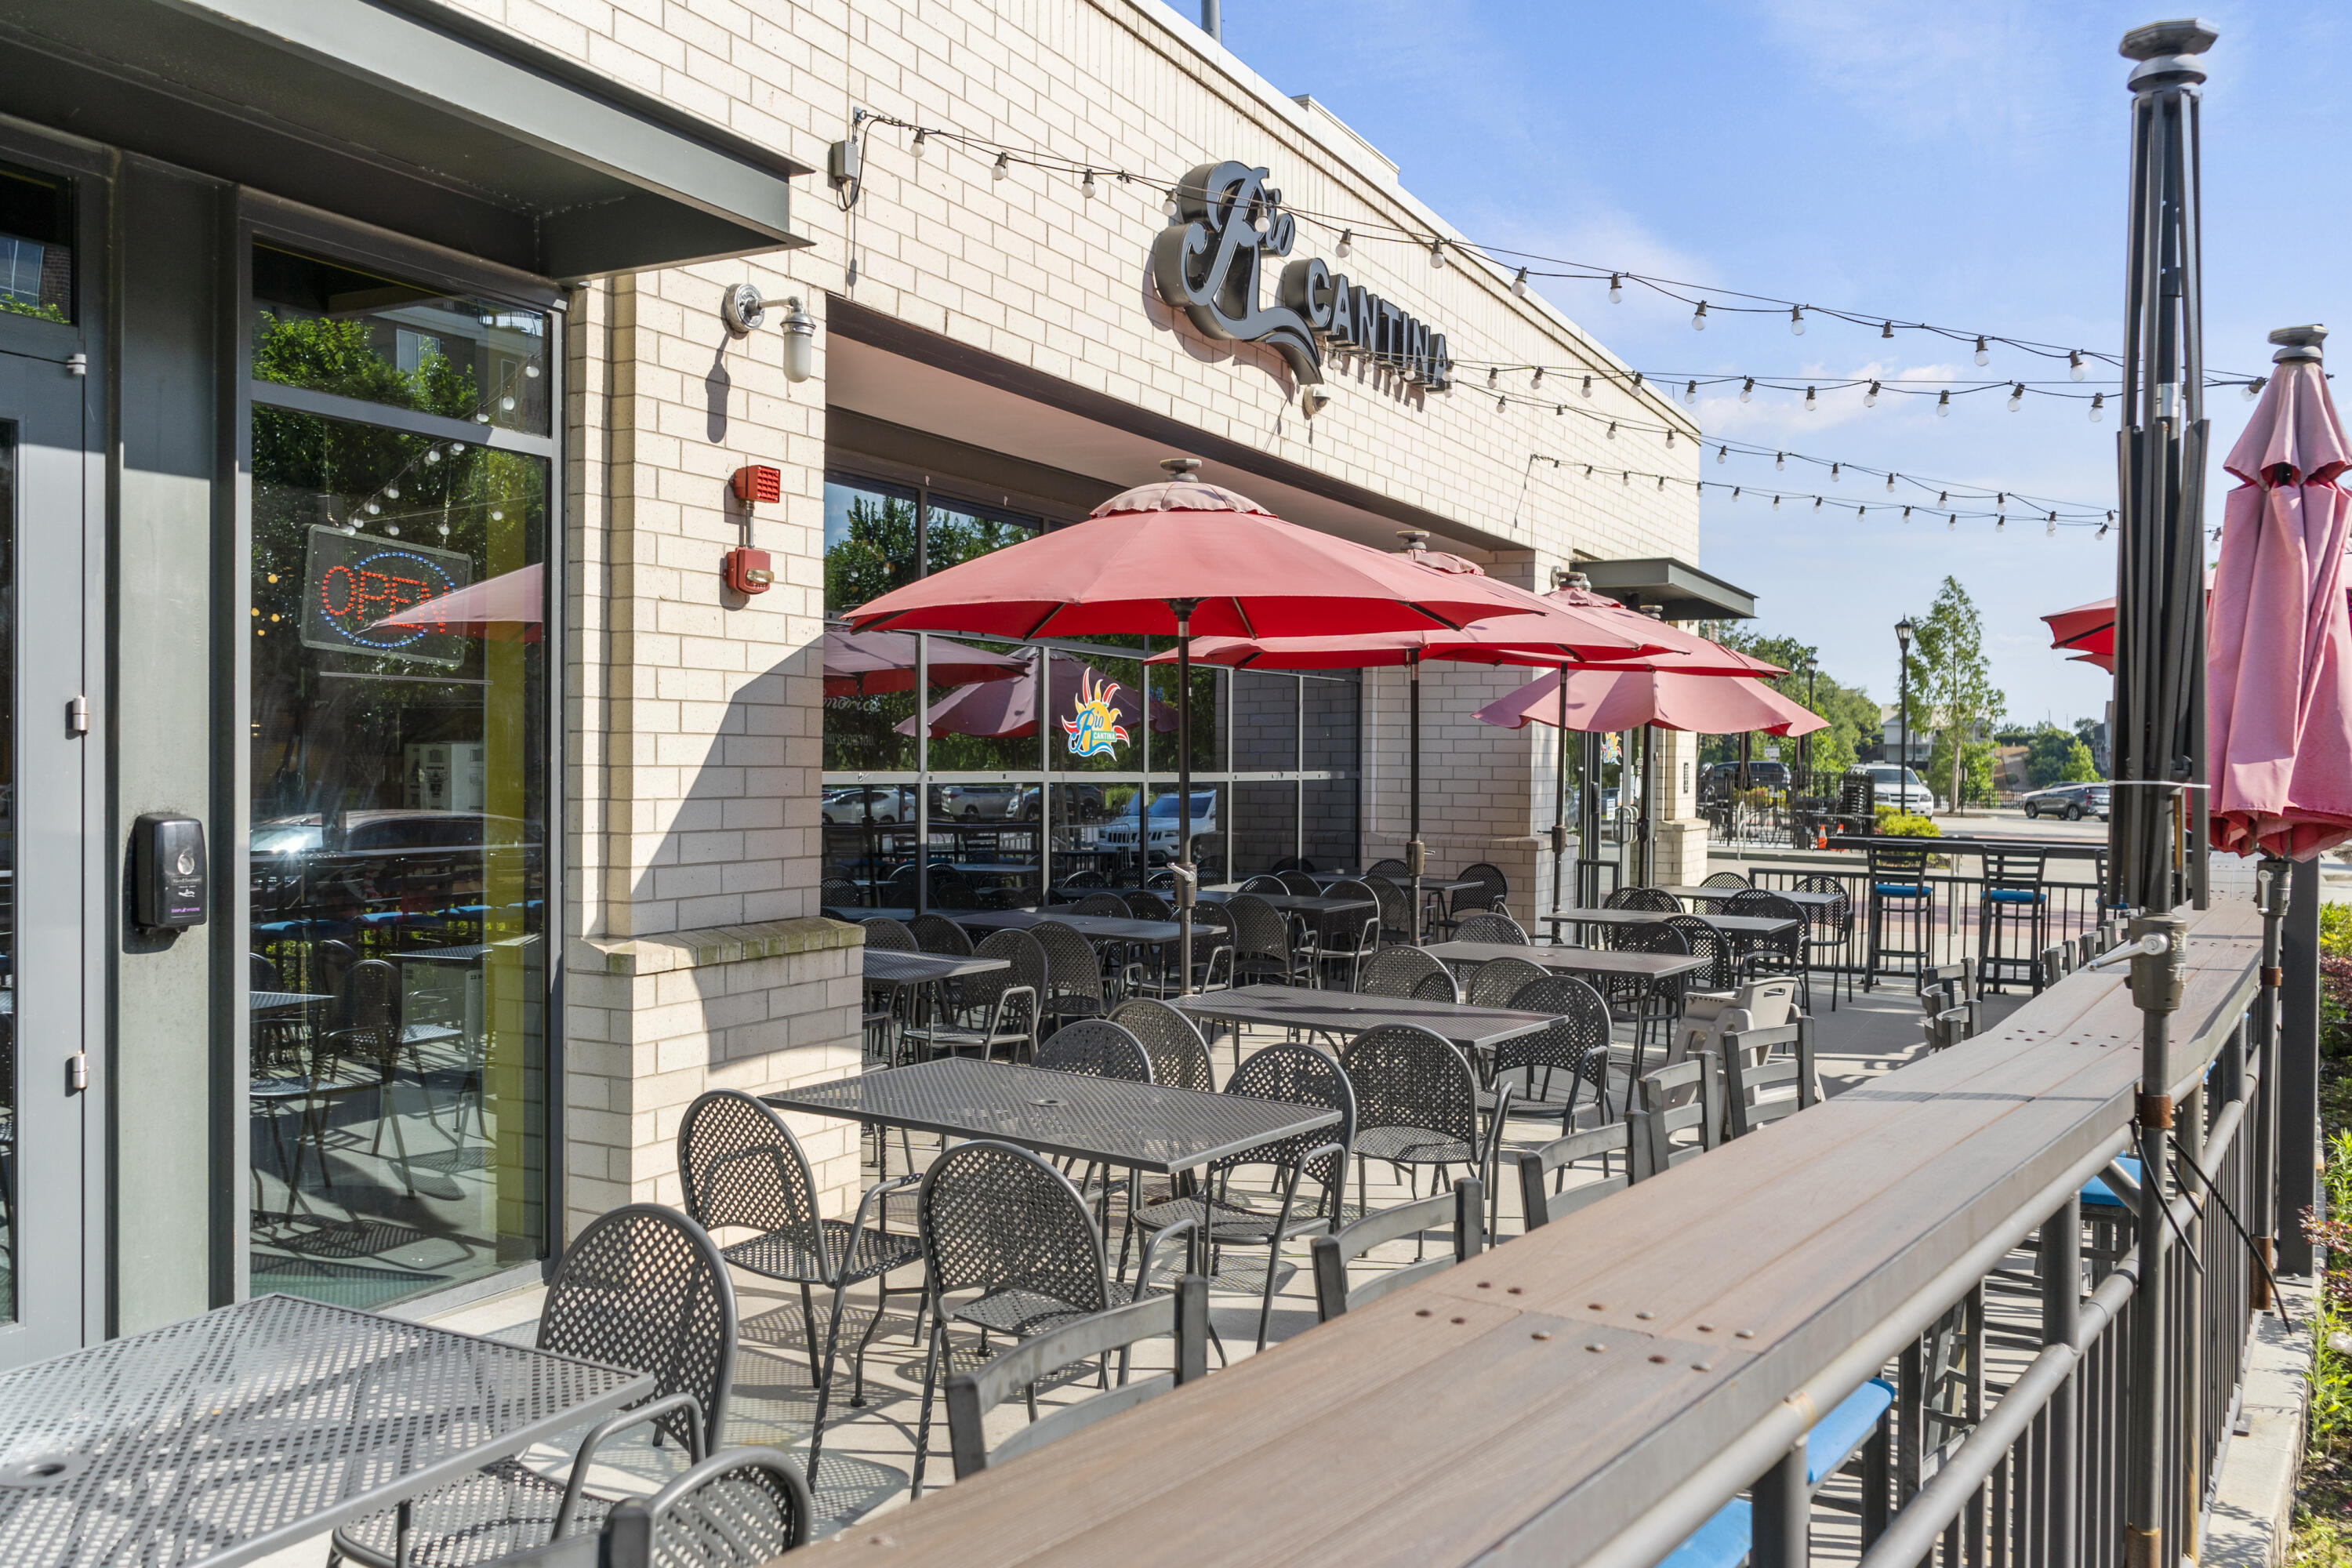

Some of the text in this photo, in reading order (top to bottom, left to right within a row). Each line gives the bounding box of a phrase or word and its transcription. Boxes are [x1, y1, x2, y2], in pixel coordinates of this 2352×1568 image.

[1156, 161, 1323, 383] Rio
[1286, 257, 1450, 386] CANTINA
[322, 565, 446, 633] OPEN
[1069, 707, 1117, 761] Rio
[1093, 732, 1116, 741] CANTINA
